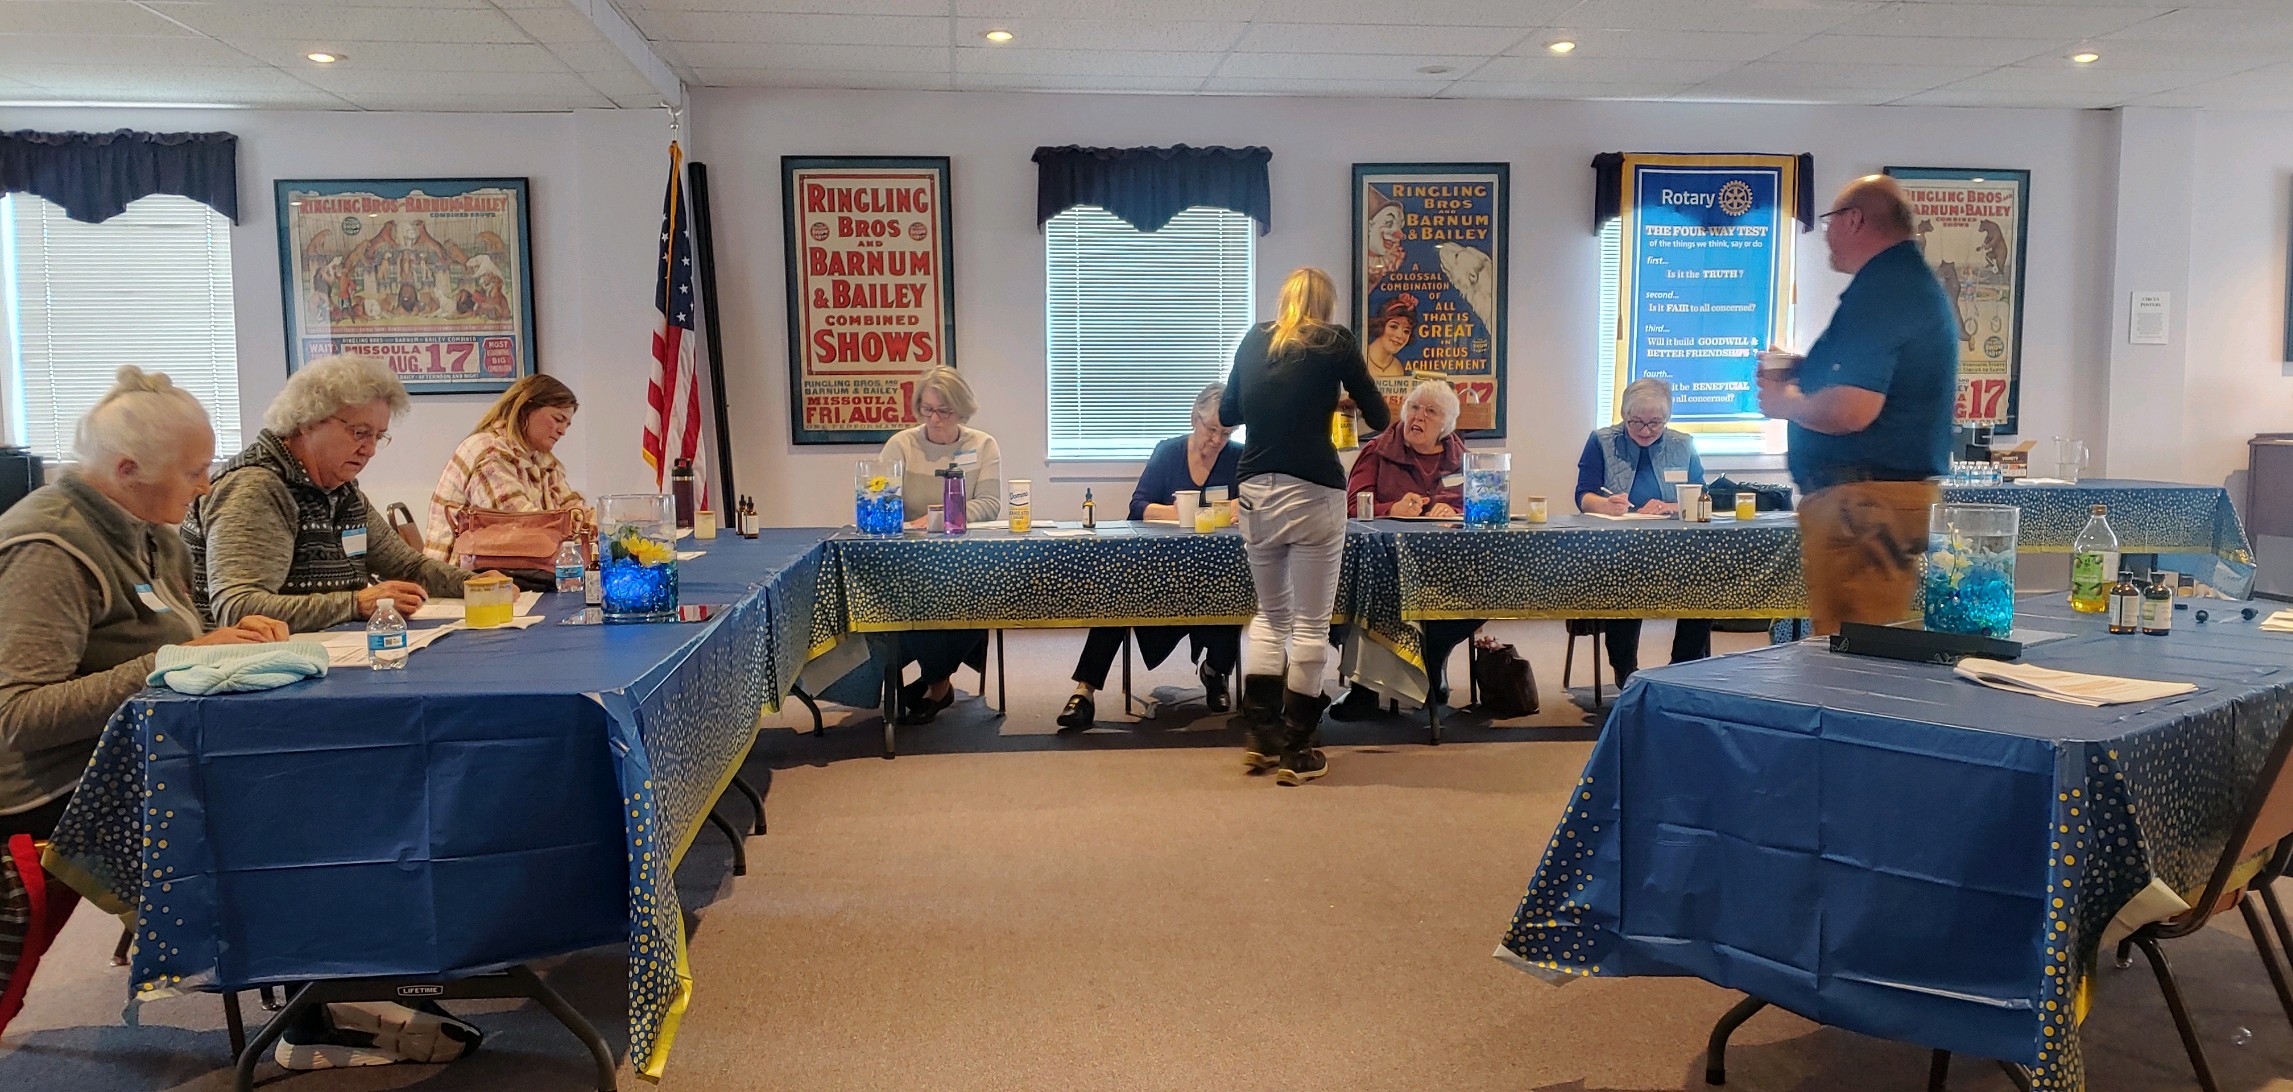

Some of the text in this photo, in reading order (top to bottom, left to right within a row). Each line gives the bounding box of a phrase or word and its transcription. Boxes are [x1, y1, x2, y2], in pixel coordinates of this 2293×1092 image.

[1392, 184, 1487, 196] RINGLING
[807, 184, 928, 213] RINGLING
[1662, 189, 1715, 208] Rotary
[1967, 190, 2002, 202] BROS
[300, 197, 360, 214] RINGLING
[362, 198, 398, 213] BROS
[464, 196, 506, 212] BAILEY
[1424, 198, 1472, 208] BROS
[1914, 204, 1958, 216] ARNUM
[1966, 204, 2010, 216] BAILEY
[1407, 214, 1488, 226] BARNUM
[838, 216, 901, 237] BROS
[1646, 224, 1768, 236] THE FOUR-WAY TEST
[1408, 227, 1488, 240] & BAILEY
[1672, 240, 1696, 249] things
[1708, 240, 1730, 248] think,
[809, 246, 930, 276] BARNUM
[1412, 263, 1419, 271] A
[1678, 270, 1684, 278] it
[1703, 270, 1738, 278] TRUTH
[1380, 282, 1450, 291] COMBINATION
[814, 280, 926, 308] & BAILEY
[1646, 291, 1680, 299] second...
[1436, 302, 1456, 310] ALL
[1666, 304, 1689, 312] FAIR
[1711, 304, 1756, 312] concerned?
[825, 315, 920, 326] COMBINED
[1423, 312, 1469, 322] THAT IS
[1418, 324, 1474, 338] GREAT
[488, 340, 508, 349] MOST
[814, 329, 934, 364] SHOWS
[1648, 337, 1758, 346] Will it build GOODWILL &
[310, 344, 332, 354] WAIT
[345, 345, 422, 356] MISSOULA
[1423, 347, 1468, 358] CIRCUS
[1647, 349, 1684, 358] BETTER
[1686, 348, 1750, 358] FRIENDSHIPS
[425, 343, 474, 373] 17
[389, 355, 422, 373] AUG.
[1405, 360, 1487, 370] ACHIEVEMENT
[1680, 382, 1690, 391] be
[1692, 382, 1750, 391] BENEFICIAL
[808, 396, 897, 406] MISSOULA
[1676, 394, 1687, 403] all
[1688, 394, 1735, 403] concerned?
[1969, 380, 2006, 418] 17
[806, 406, 900, 424] FRI. AUG
[1010, 492, 1029, 500] Domino
